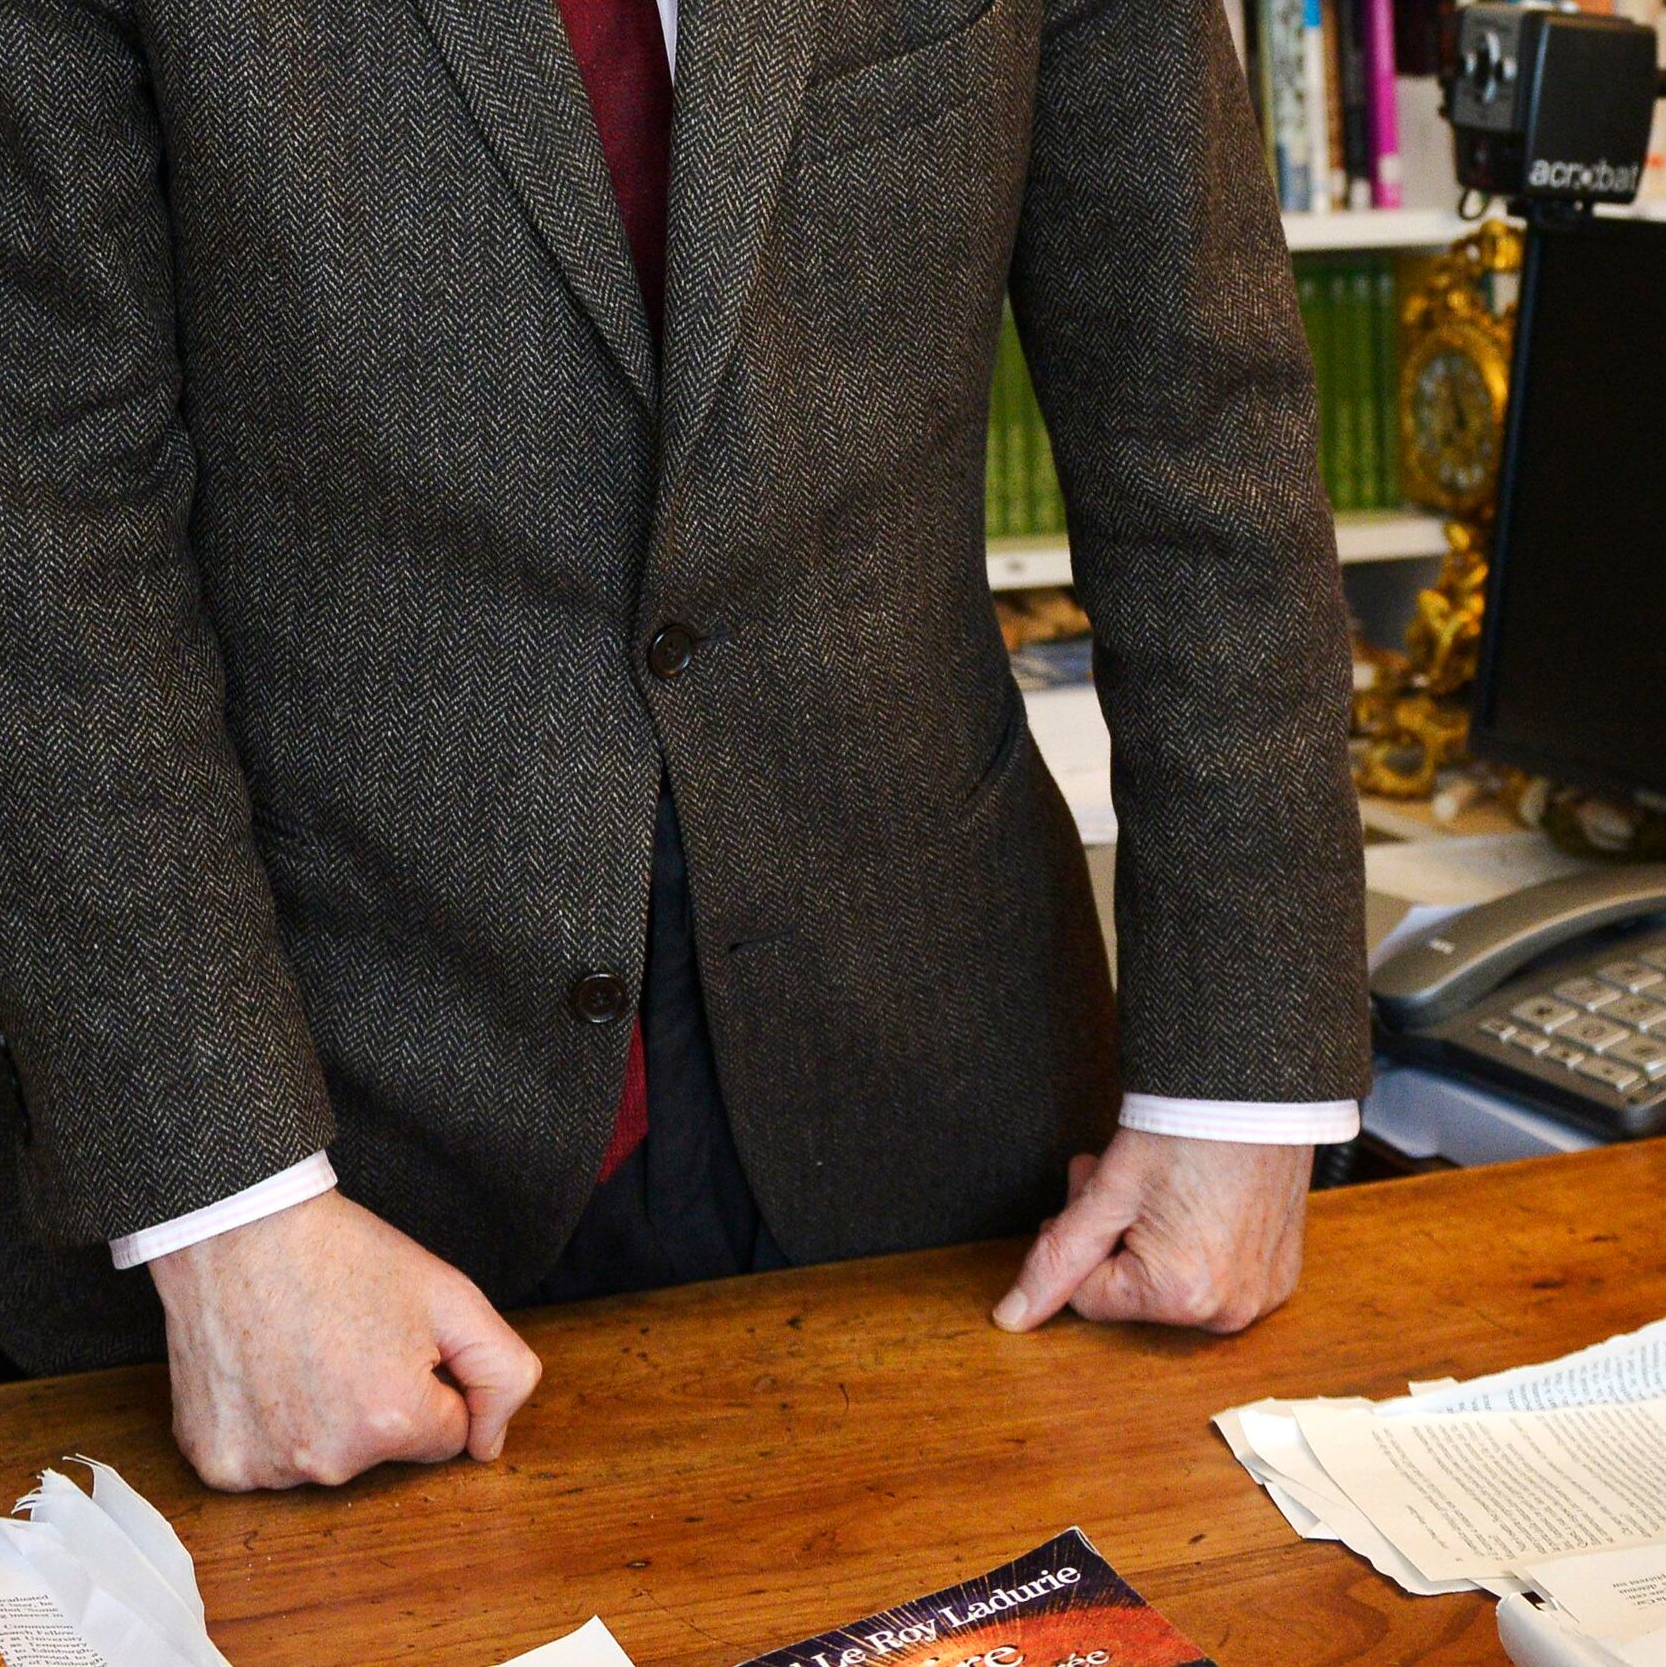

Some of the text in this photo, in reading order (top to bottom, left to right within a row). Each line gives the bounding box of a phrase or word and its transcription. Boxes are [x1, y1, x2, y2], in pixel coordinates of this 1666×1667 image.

[810, 1646, 867, 1667] Le
[864, 1617, 942, 1658] Roy
[937, 1563, 1082, 1628] Ladurie
